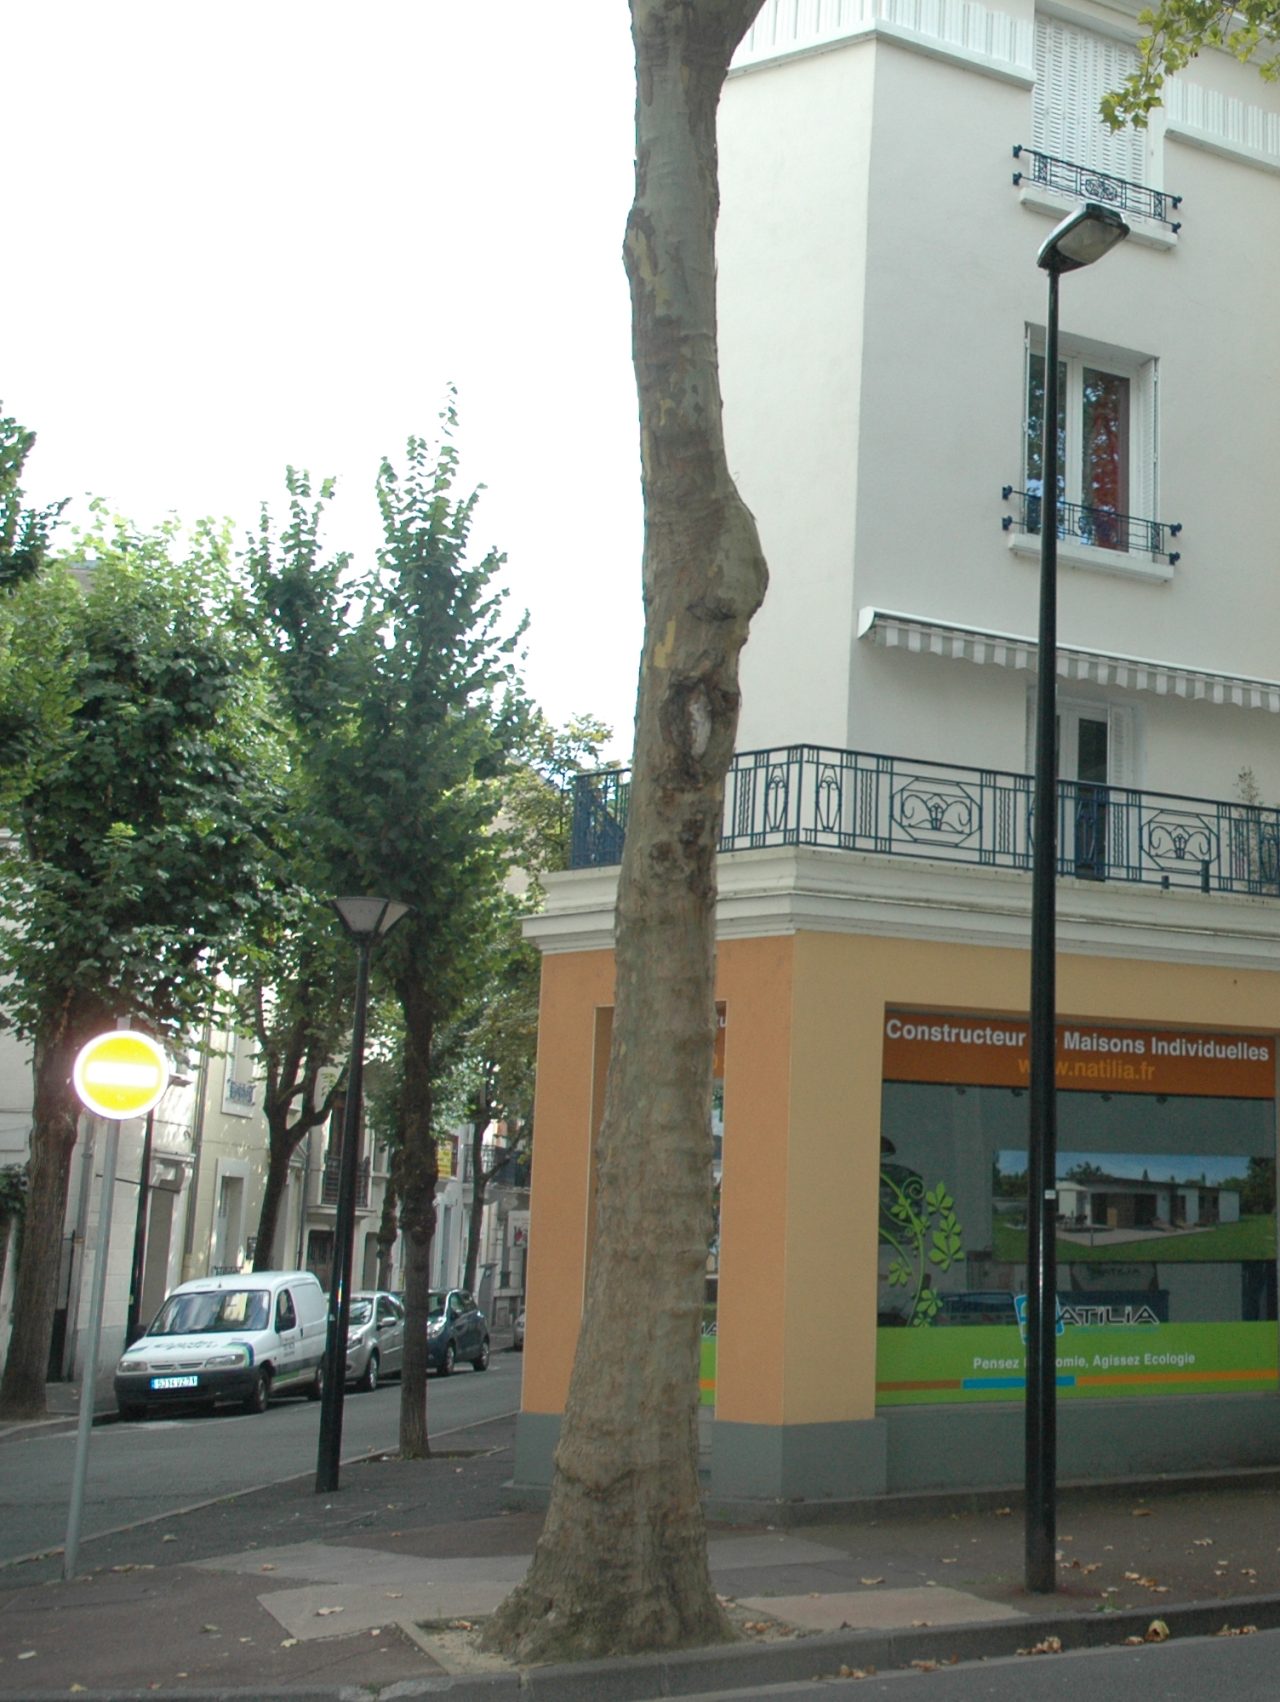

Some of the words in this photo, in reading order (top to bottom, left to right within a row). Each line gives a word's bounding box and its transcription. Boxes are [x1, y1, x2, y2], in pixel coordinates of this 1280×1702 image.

[886, 1018, 1026, 1047] Constructeur
[1064, 1031, 1145, 1054] Maisons
[1151, 1036, 1270, 1061] Individuelles
[1018, 1059, 1155, 1080] ww.natilia.fr
[973, 1358, 1019, 1369] Pensez
[1092, 1352, 1141, 1369] Agissez
[1144, 1351, 1196, 1368] Ecologie
